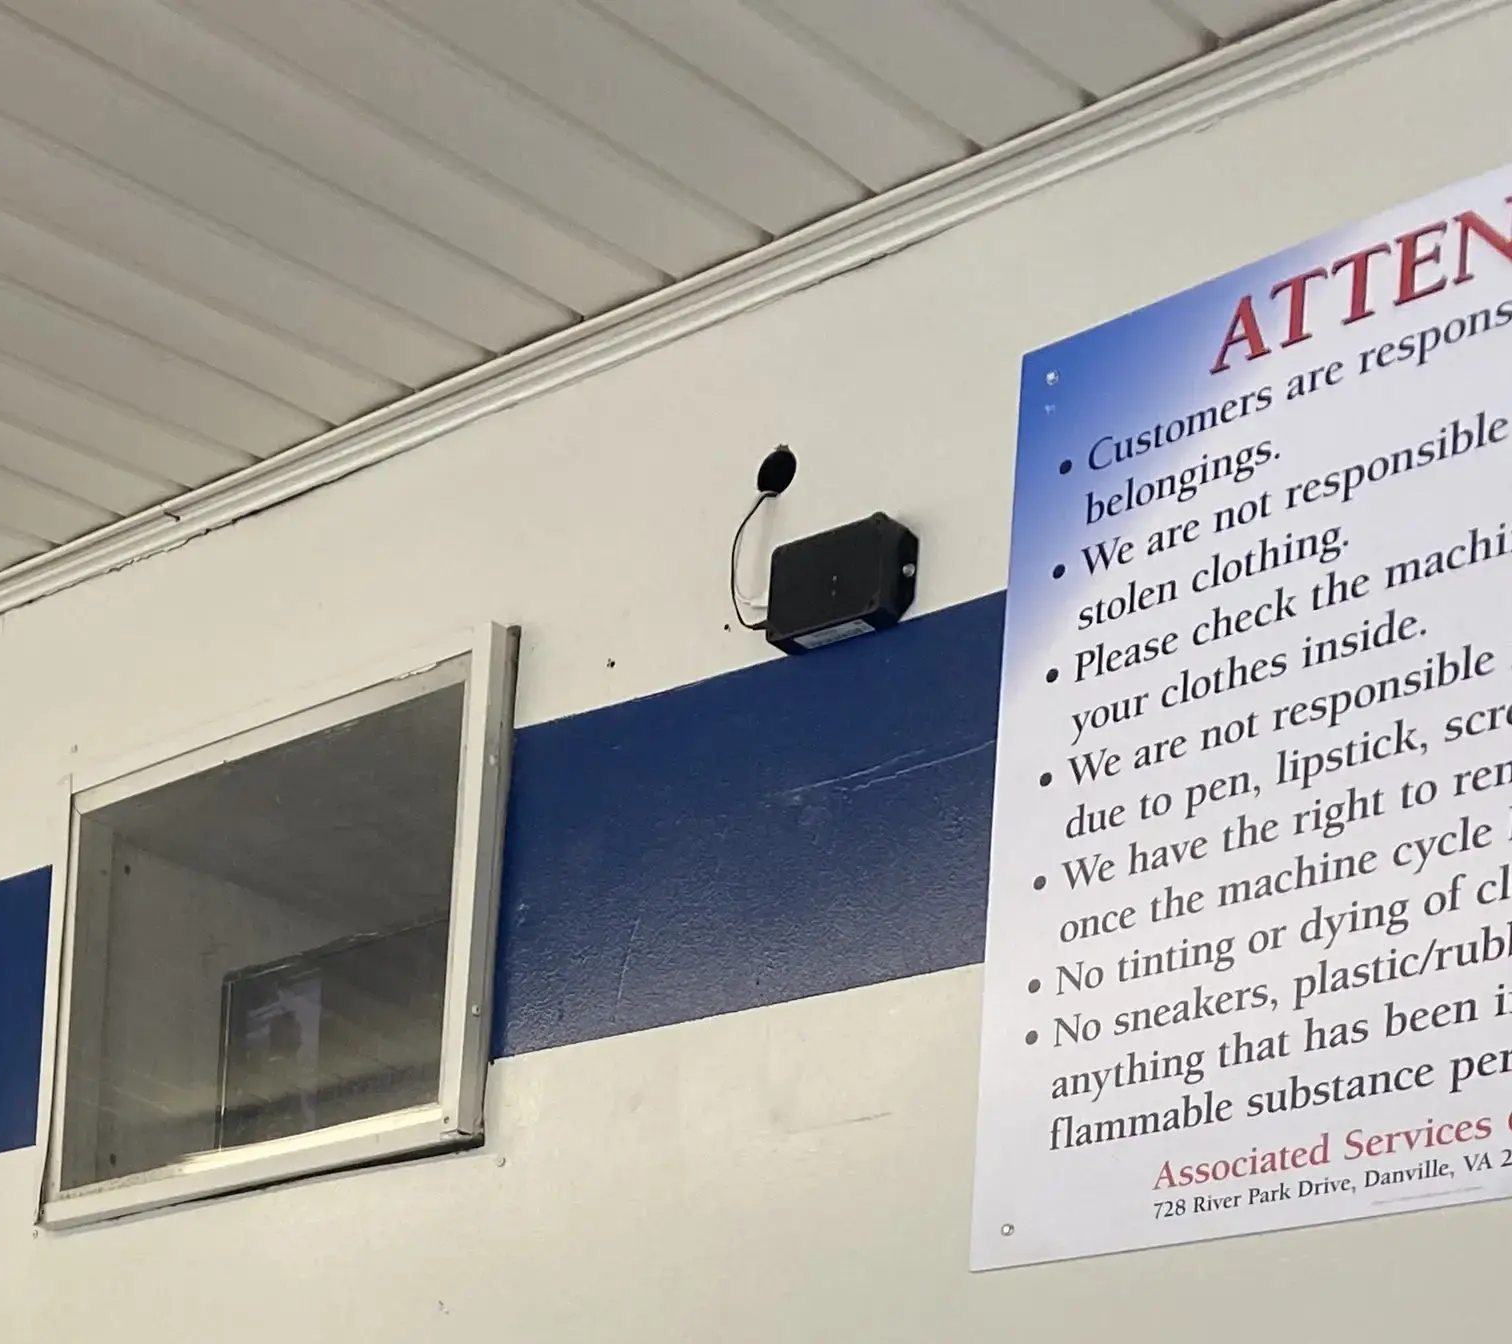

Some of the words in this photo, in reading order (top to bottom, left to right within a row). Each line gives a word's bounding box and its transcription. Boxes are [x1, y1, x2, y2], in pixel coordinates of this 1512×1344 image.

[1088, 385, 1273, 471] Customers
[1286, 361, 1344, 401] are
[1080, 535, 1135, 577] We
[1146, 519, 1201, 557] are
[1212, 490, 1272, 534] not
[1285, 410, 1509, 511] responsible
[1086, 439, 1281, 526] belongings.
[1073, 632, 1179, 684] Please
[1192, 585, 1298, 647] check
[1311, 570, 1371, 611] the
[1384, 522, 1512, 591] machi
[1077, 579, 1179, 631] stolen
[1191, 526, 1349, 594] clothing.
[1067, 747, 1122, 786] We
[1133, 735, 1188, 770] are
[1200, 711, 1260, 752] not
[1272, 643, 1495, 733] responsible
[1070, 691, 1150, 747] your
[1160, 652, 1288, 709] clothes
[1301, 608, 1427, 670] inside.
[1060, 852, 1116, 890] We
[1127, 836, 1208, 877] have
[1222, 813, 1280, 853] the
[1292, 786, 1386, 839] right
[1400, 780, 1438, 810] to
[1065, 802, 1126, 839] due
[1139, 792, 1173, 821] to
[1184, 771, 1261, 821] pen,
[1275, 718, 1428, 791] lipstick,
[1055, 960, 1104, 996] No
[1117, 936, 1236, 983] tinting
[1248, 924, 1288, 955] or
[1299, 898, 1410, 951] dying
[1423, 872, 1468, 917] of
[1059, 906, 1137, 943] once
[1150, 885, 1205, 923] the
[1217, 850, 1378, 908] machine
[1392, 815, 1493, 876] cycle
[1053, 1012, 1102, 1048] No
[1113, 983, 1278, 1036] sneakers,
[1292, 920, 1512, 1012] plastic/rub
[1049, 1090, 1233, 1151] flammable
[1246, 1063, 1435, 1118] substance
[1051, 1049, 1206, 1104] anything
[1218, 1030, 1291, 1069] that
[1303, 1016, 1369, 1053] has
[1383, 998, 1479, 1039] been
[1152, 1131, 1330, 1191] Associated
[1343, 1110, 1492, 1162] Services
[1153, 1198, 1187, 1220] 728
[1193, 1194, 1243, 1214] River
[1248, 1182, 1292, 1206] Park
[1297, 1178, 1357, 1198] Drive,
[1364, 1158, 1455, 1189] Danville,
[1462, 1151, 1494, 1172] VA
